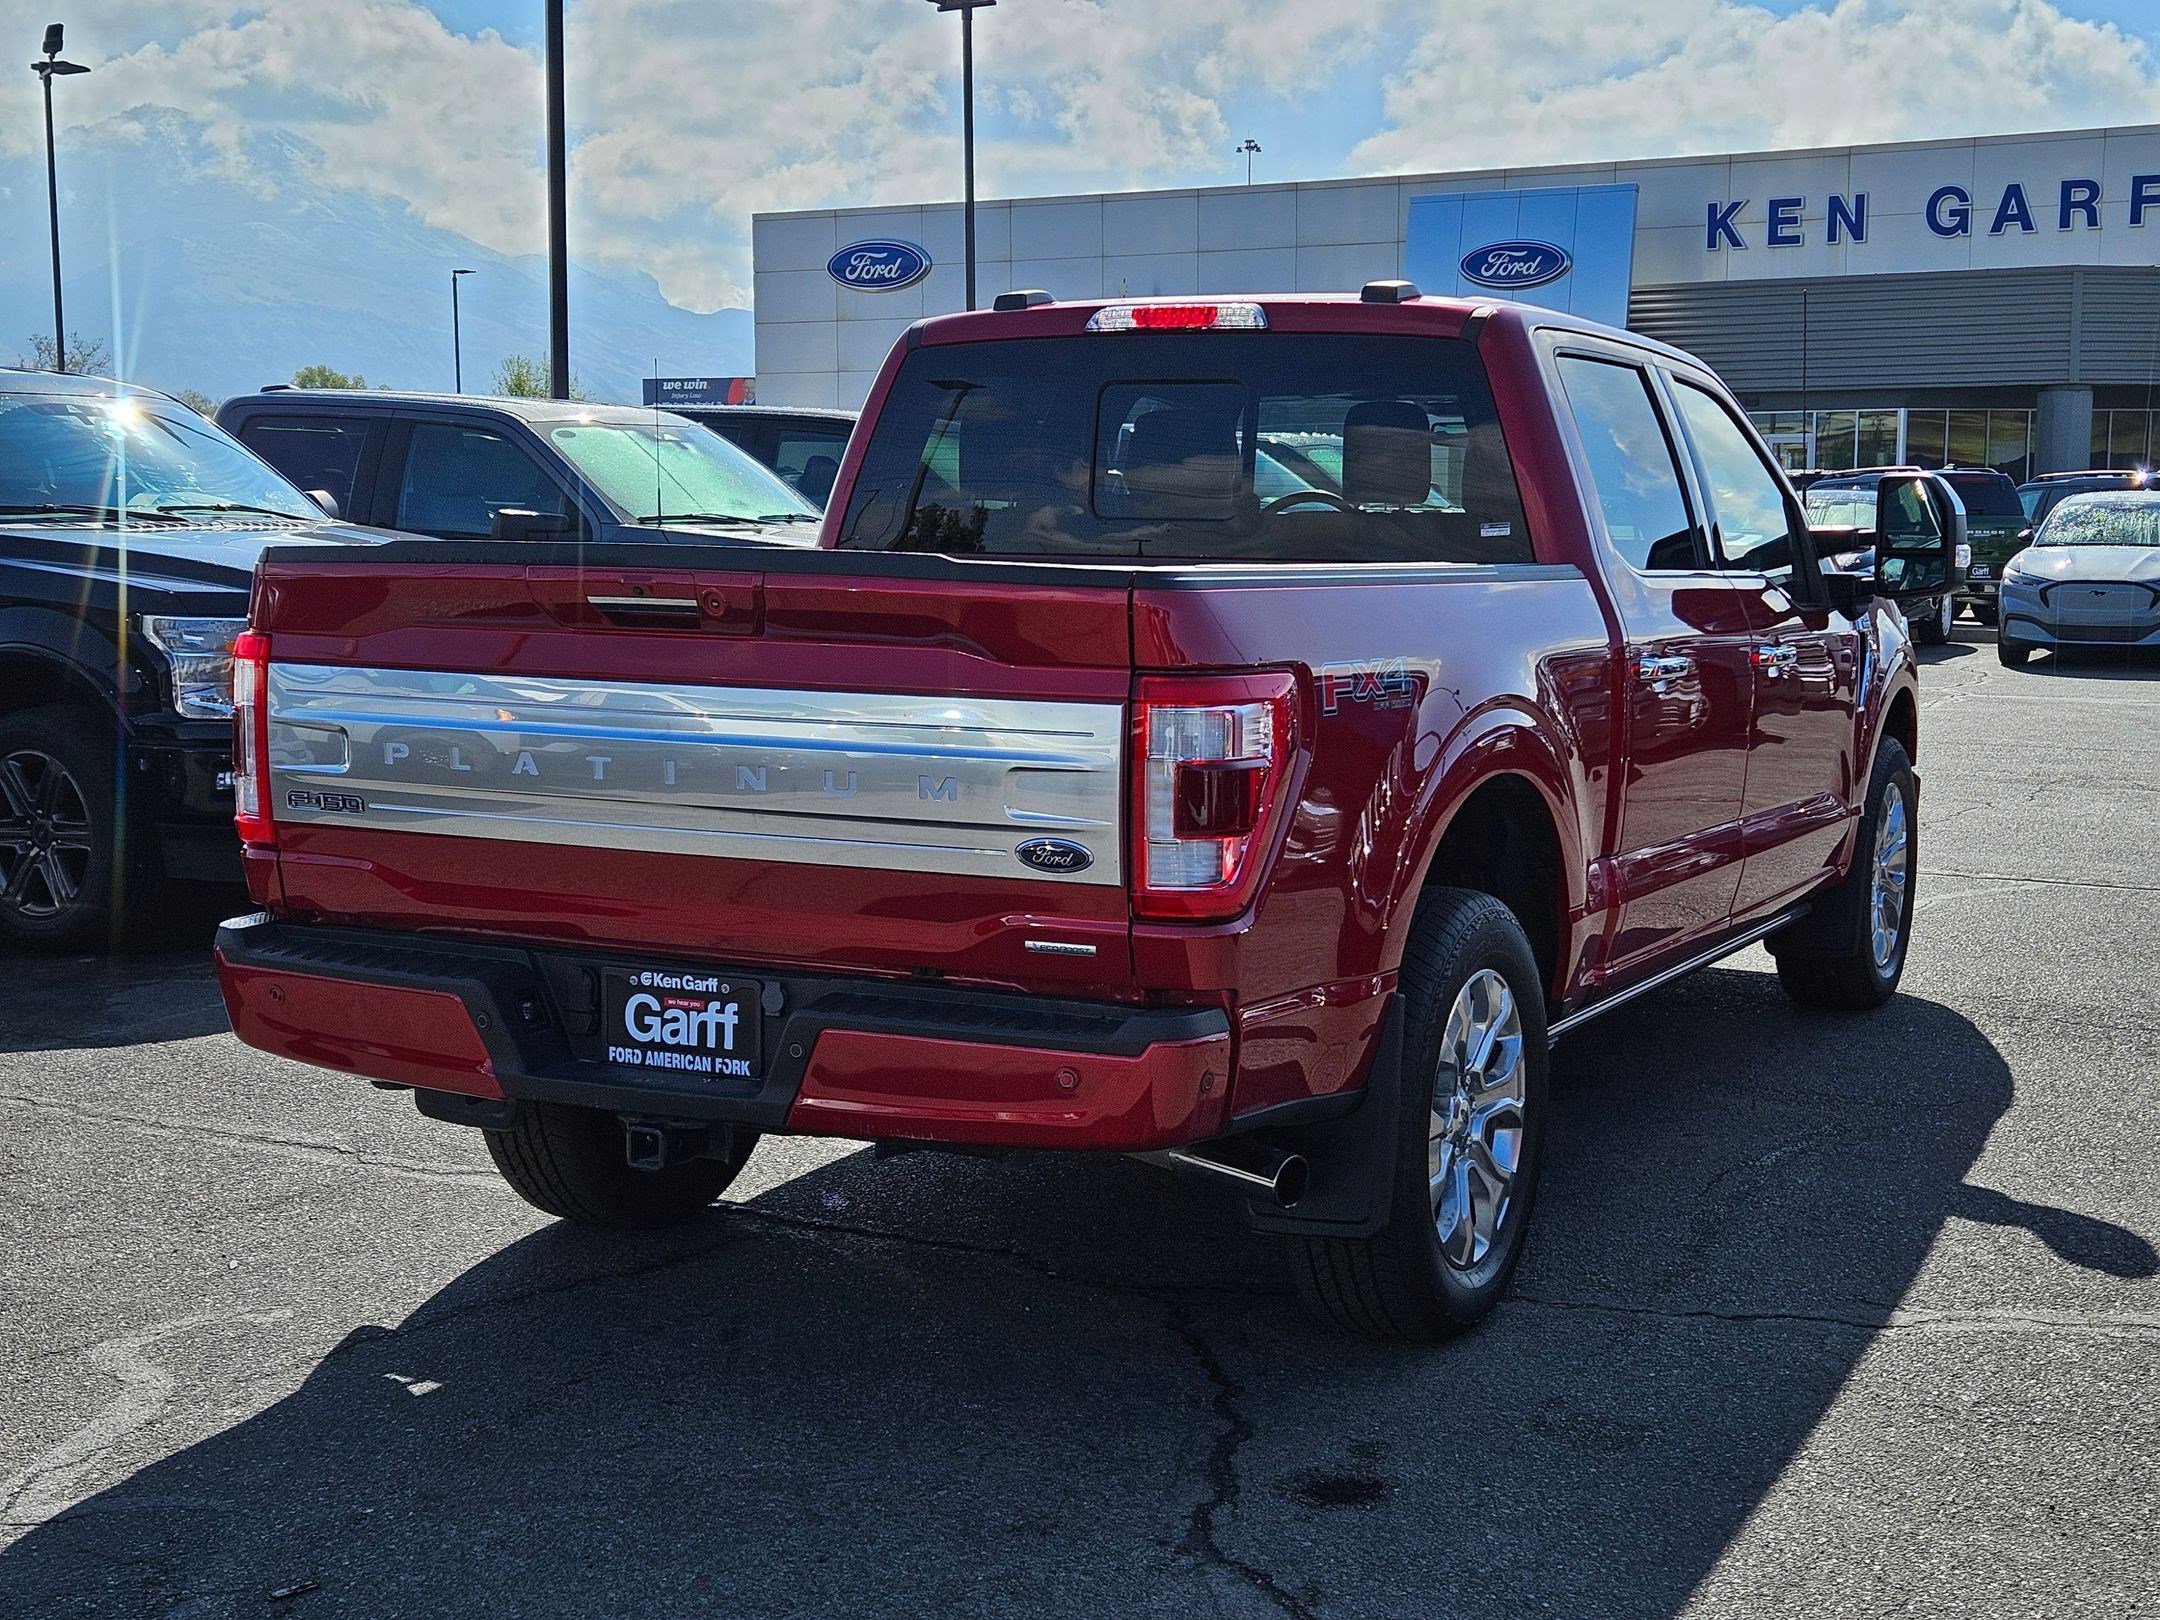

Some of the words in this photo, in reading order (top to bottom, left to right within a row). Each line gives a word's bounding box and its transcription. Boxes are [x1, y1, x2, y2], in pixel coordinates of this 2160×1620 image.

[1705, 192, 1869, 251] KEN
[1924, 173, 2160, 238] GARF
[845, 252, 902, 280] Ford
[1480, 250, 1542, 277] Ford
[663, 381, 682, 390] we
[1320, 656, 1412, 716] FX4
[383, 741, 958, 802] PLATINUM
[286, 789, 366, 815] F-150
[1032, 845, 1074, 866] Ford
[653, 973, 681, 989] Ken
[682, 974, 719, 993] Garff
[676, 999, 689, 1007] hear
[689, 1001, 701, 1009] you
[625, 993, 739, 1050] Garff
[608, 1046, 642, 1065] FORD
[645, 1050, 712, 1073] AMERICAN
[715, 1058, 751, 1077] FORK
